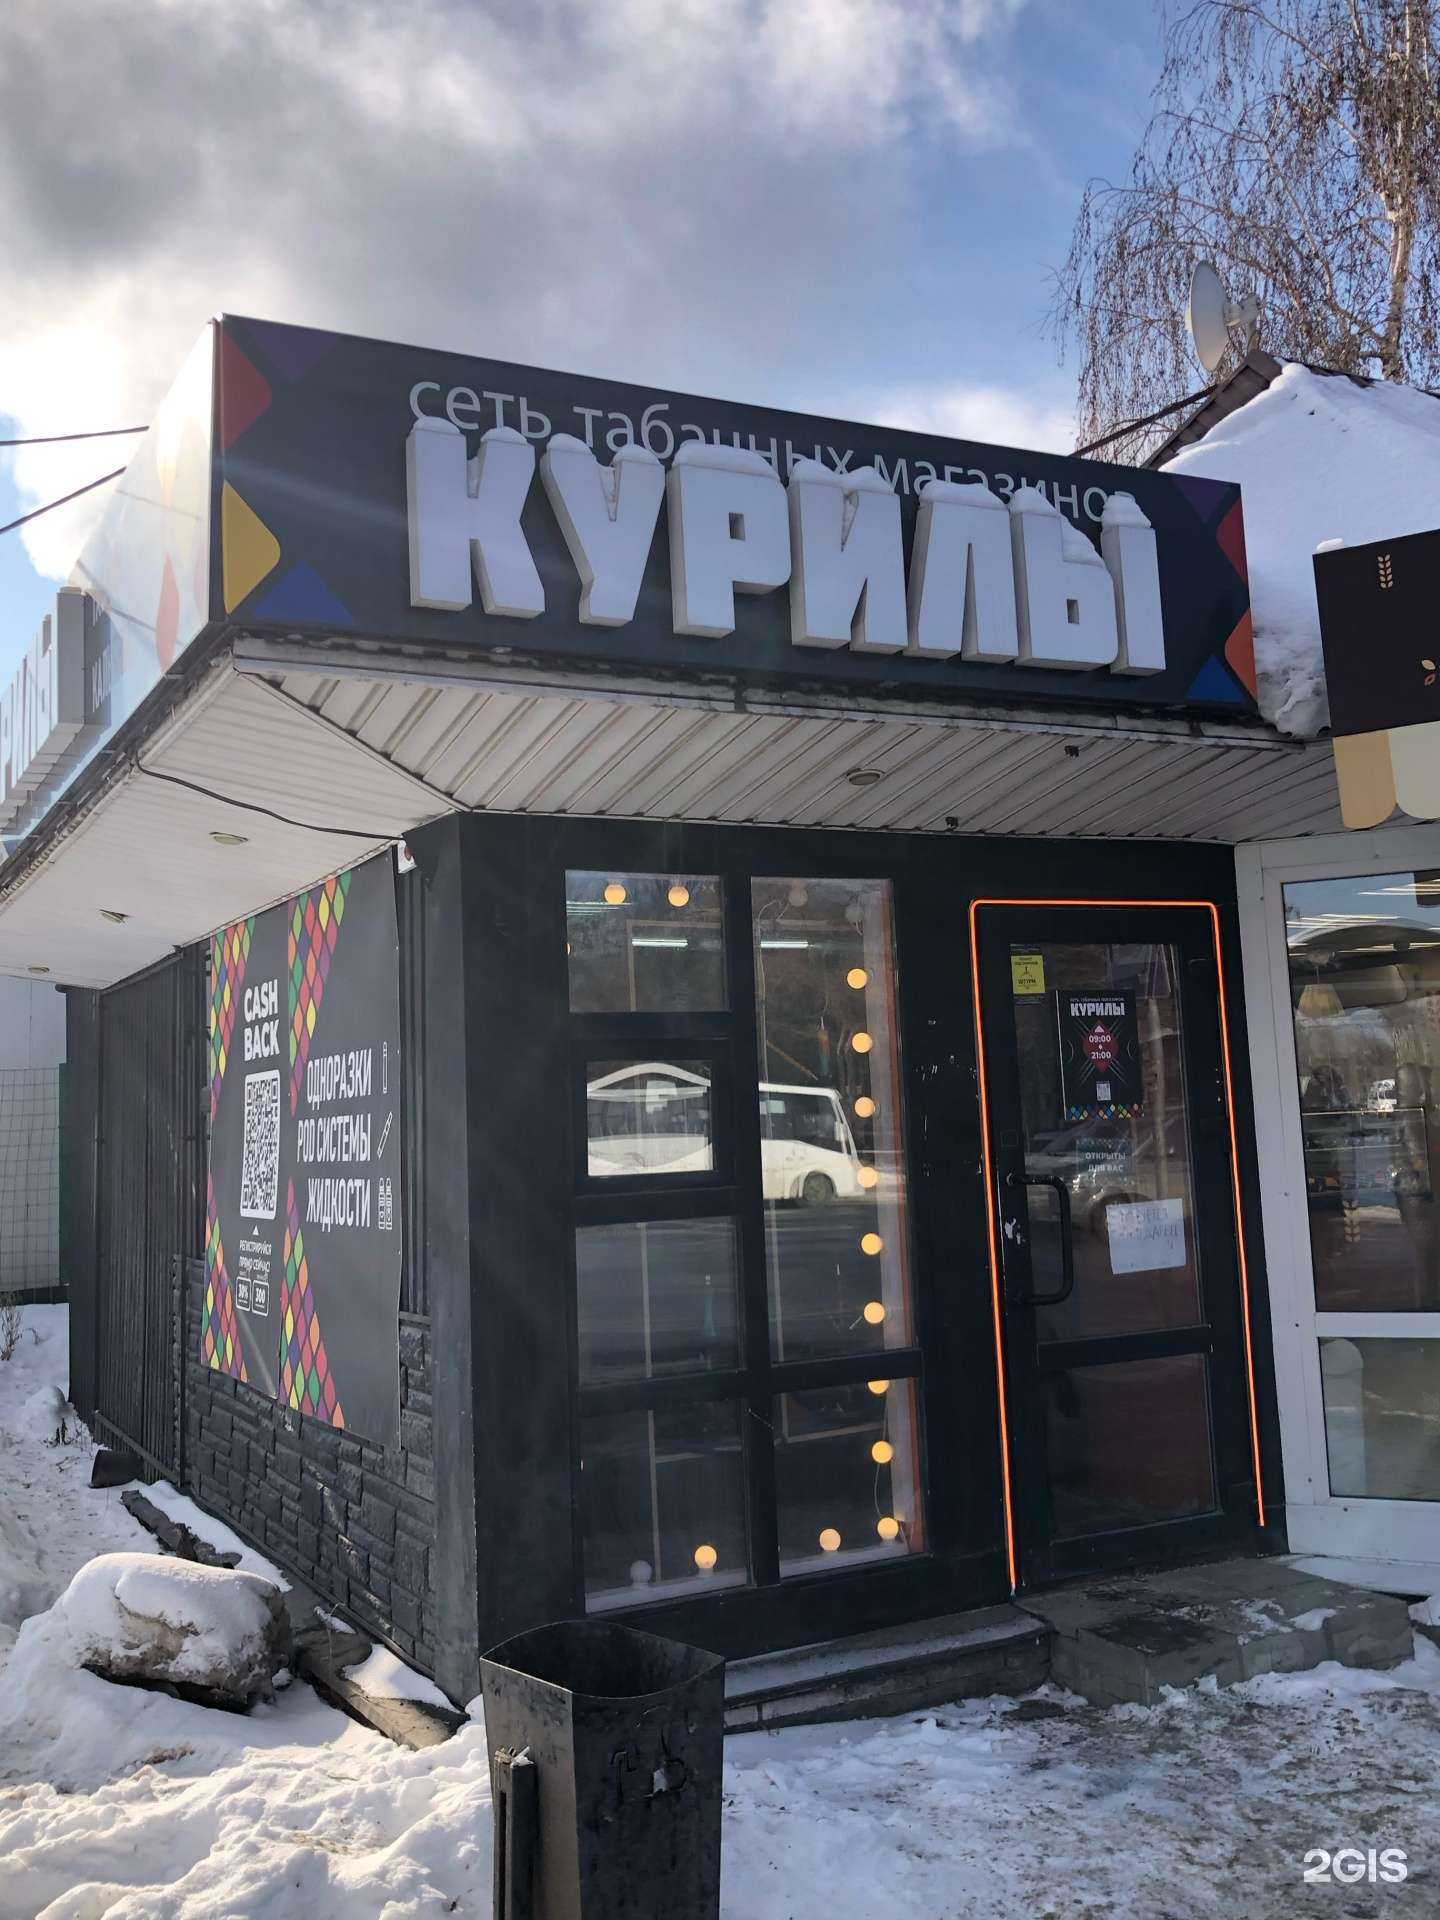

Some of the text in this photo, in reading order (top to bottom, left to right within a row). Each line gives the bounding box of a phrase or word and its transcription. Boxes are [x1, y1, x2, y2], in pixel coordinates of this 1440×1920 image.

[409, 380, 553, 440] сеть
[406, 418, 1165, 676] КУРИЛЫ
[244, 978, 279, 1022] CASH
[1070, 1002, 1125, 1017] КУРИЛЫ
[244, 1019, 280, 1062] BACK
[1088, 1035, 1112, 1043] 09:00
[1091, 1051, 1112, 1060] 21:00
[306, 1048, 372, 1111] ОДНОРАЗКИ
[316, 1113, 371, 1163] СИСТЕМЫ
[1085, 1151, 1126, 1160] ОТКРЫТЫ
[306, 1177, 371, 1232] ЖИДКОСТИ
